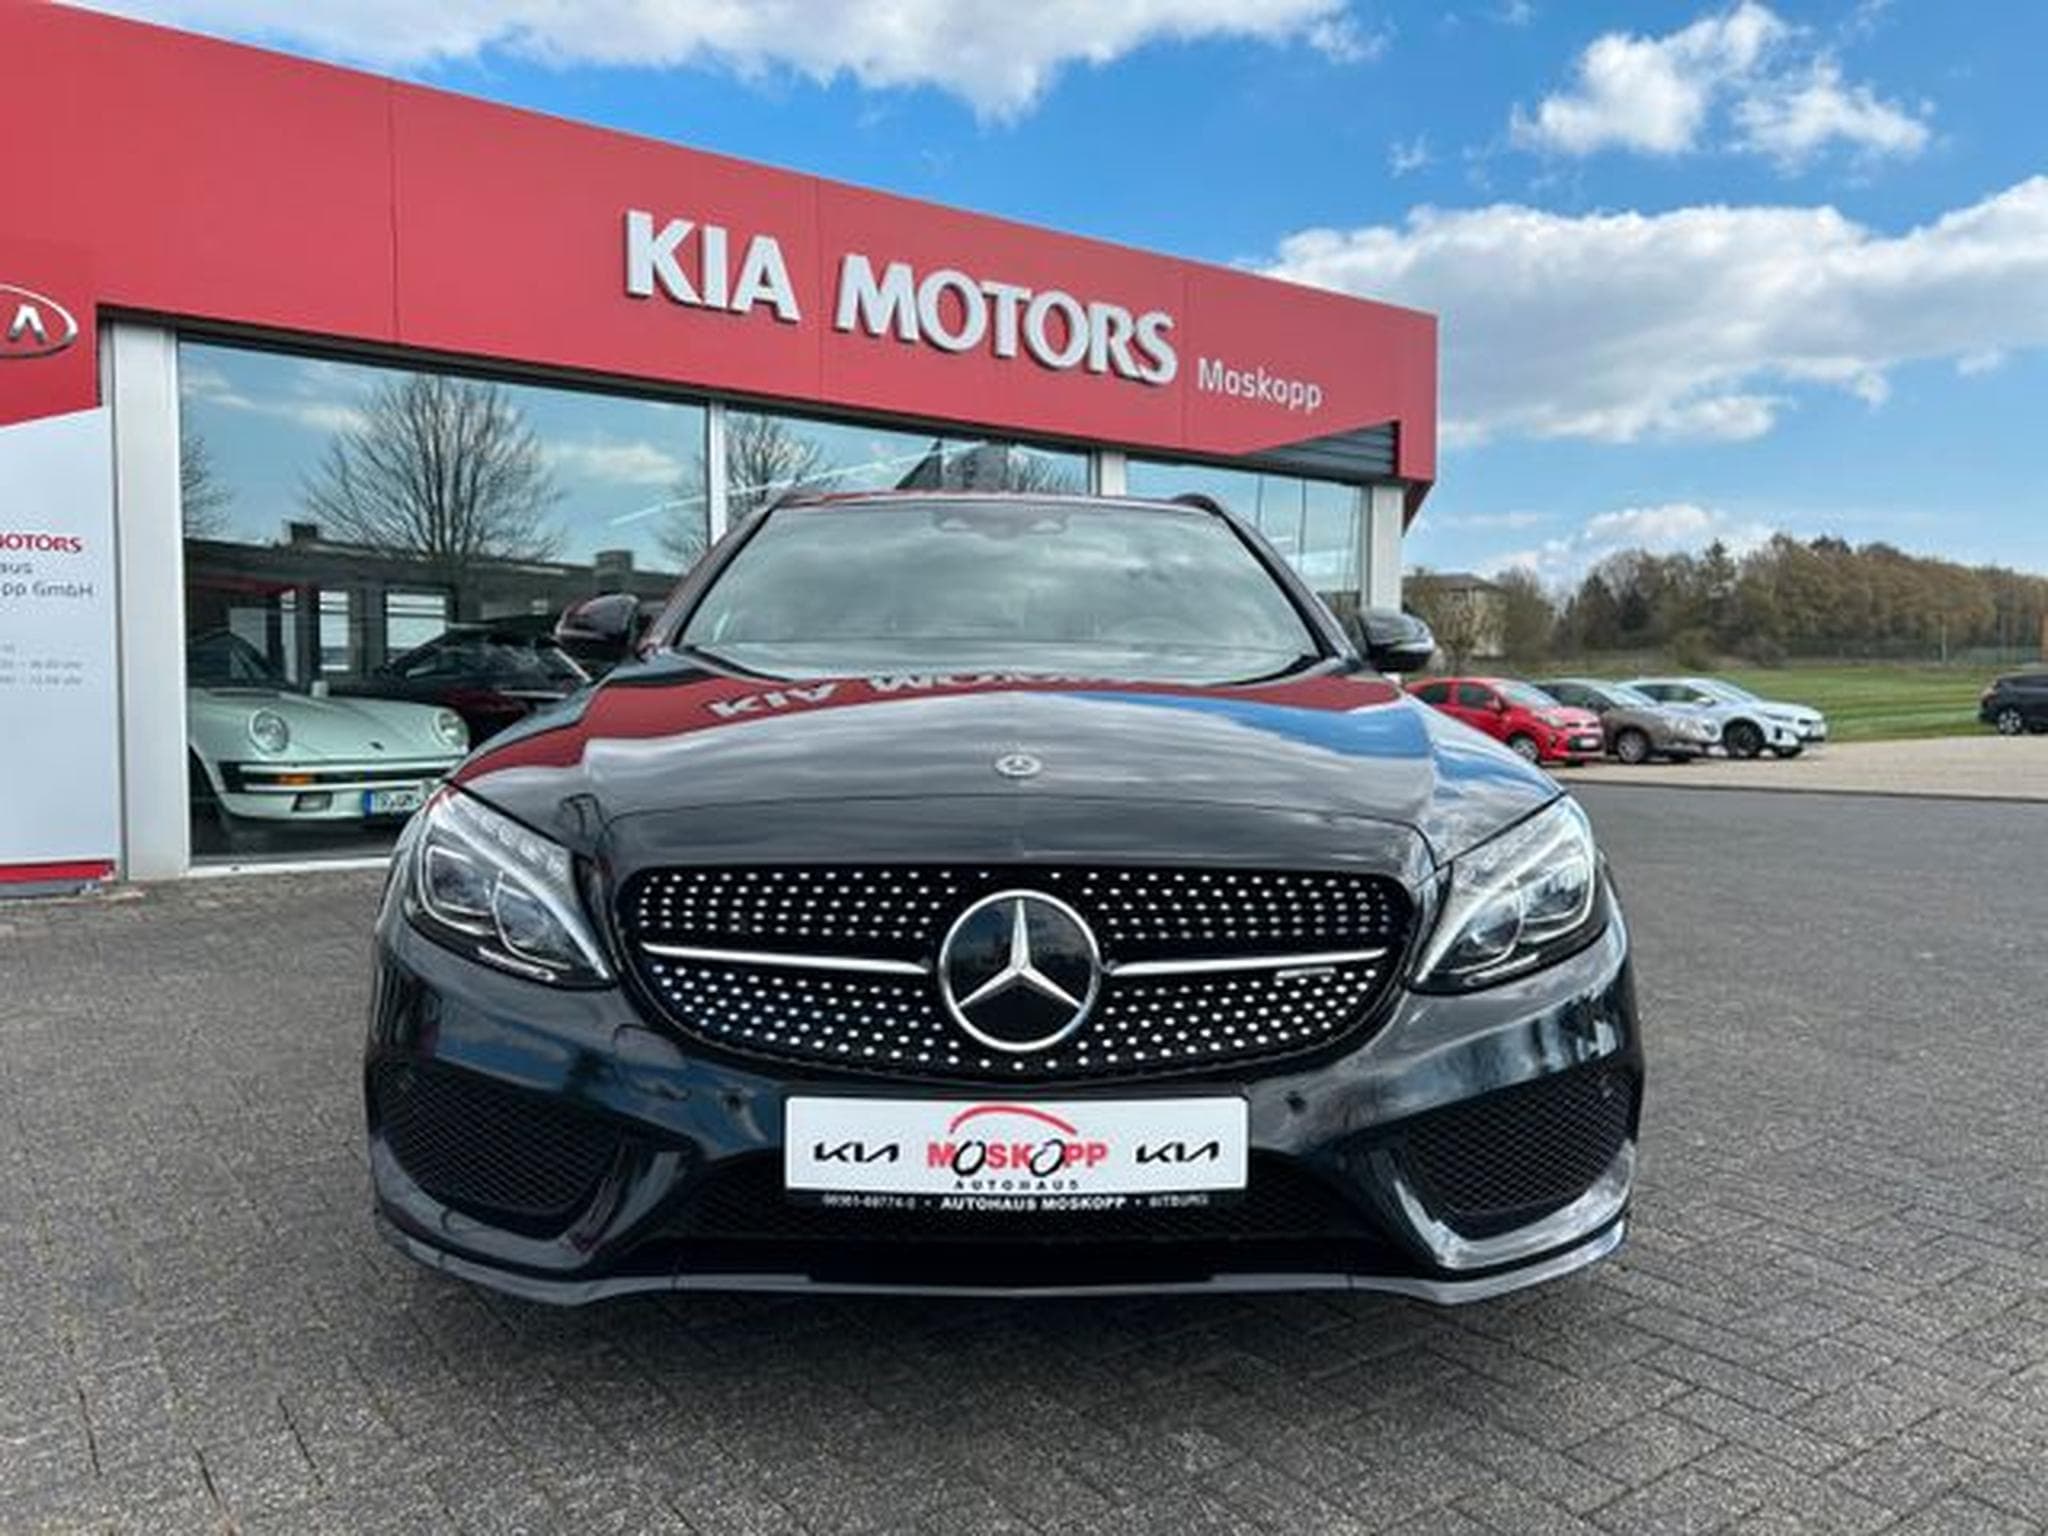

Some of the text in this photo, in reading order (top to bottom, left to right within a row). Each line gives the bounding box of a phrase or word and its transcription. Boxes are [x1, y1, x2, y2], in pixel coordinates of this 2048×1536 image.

[625, 208, 1178, 385] KIA MOTORS
[1198, 358, 1322, 410] Moskopp
[0, 533, 83, 553] OTORS
[32, 581, 94, 597] GmbH
[927, 1138, 1109, 1177] MOSKOPP
[954, 1180, 1079, 1191] AUTOHAUS
[940, 1195, 1037, 1211] AUTOHAUS
[1041, 1195, 1127, 1211] MOSKOPP
